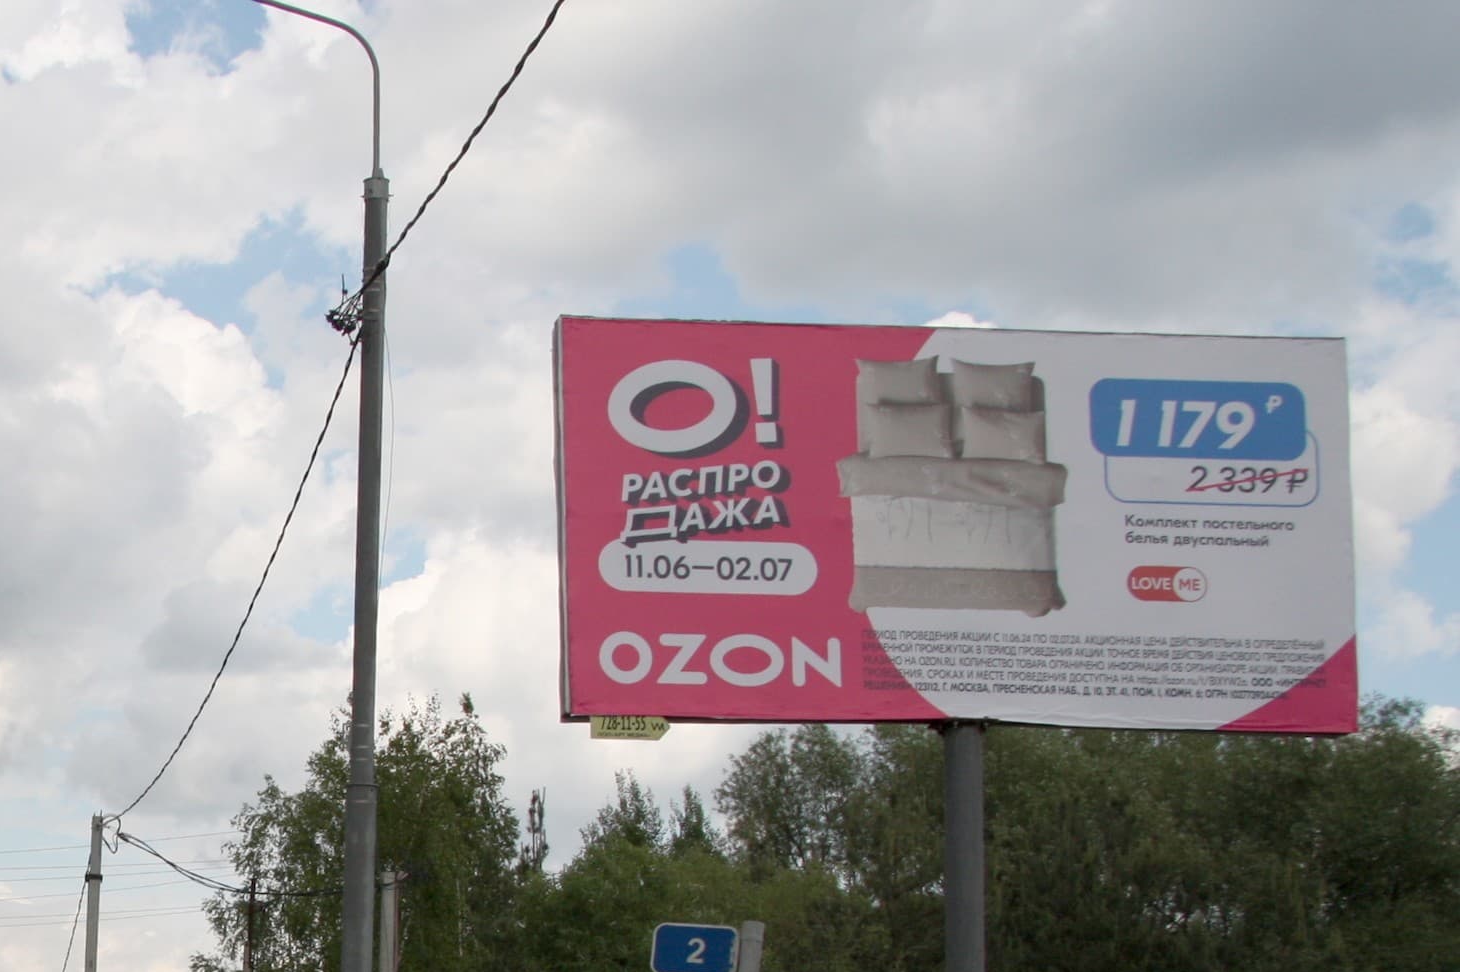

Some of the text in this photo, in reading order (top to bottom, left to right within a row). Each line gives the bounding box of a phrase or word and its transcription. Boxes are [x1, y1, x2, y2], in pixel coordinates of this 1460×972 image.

[621, 460, 784, 503] РАСПРО
[619, 495, 783, 544] ДАЖА
[1124, 514, 1296, 532] Комплект постельного
[1125, 531, 1270, 548] белья двуспальный
[1131, 576, 1202, 592] LOVE ME
[900, 630, 958, 640] ПРОВЕДЕНИЯ
[961, 631, 991, 641] АКЦИИ
[915, 642, 973, 653] ПРОМЕЖУТОК
[598, 630, 843, 688] OZON
[685, 937, 707, 964] 2
